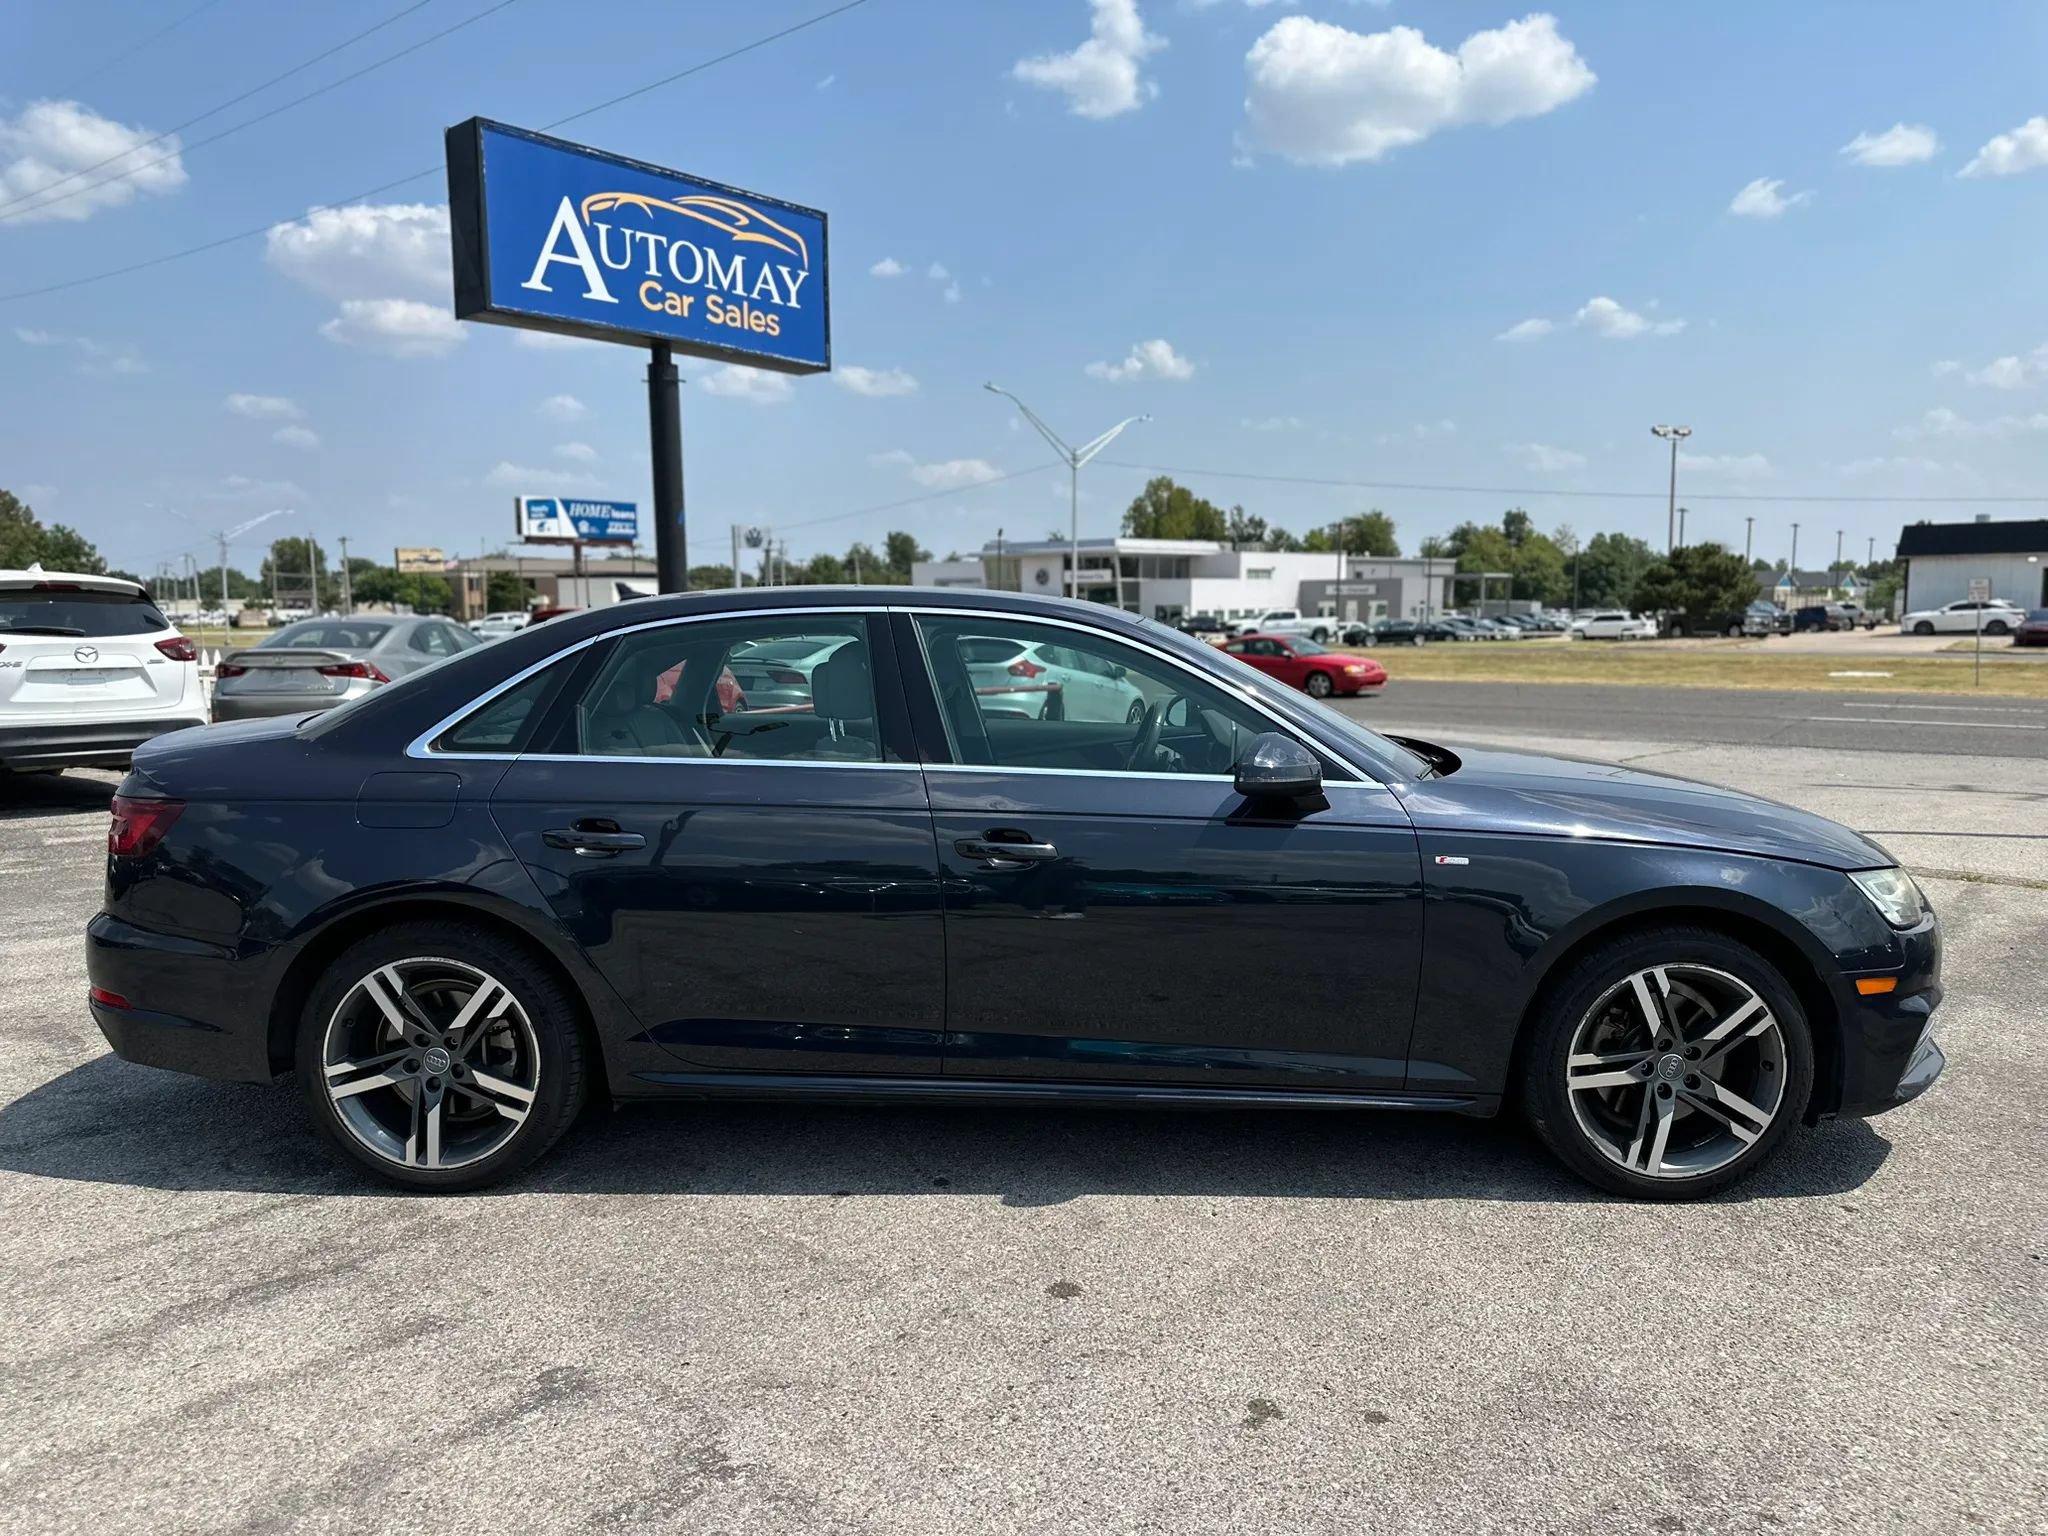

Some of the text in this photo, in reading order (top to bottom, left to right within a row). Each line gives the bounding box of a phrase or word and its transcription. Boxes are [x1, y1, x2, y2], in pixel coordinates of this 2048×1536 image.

[521, 196, 808, 308] AUTOMAY
[640, 281, 780, 336] Car Sales
[570, 503, 611, 518] HOME
